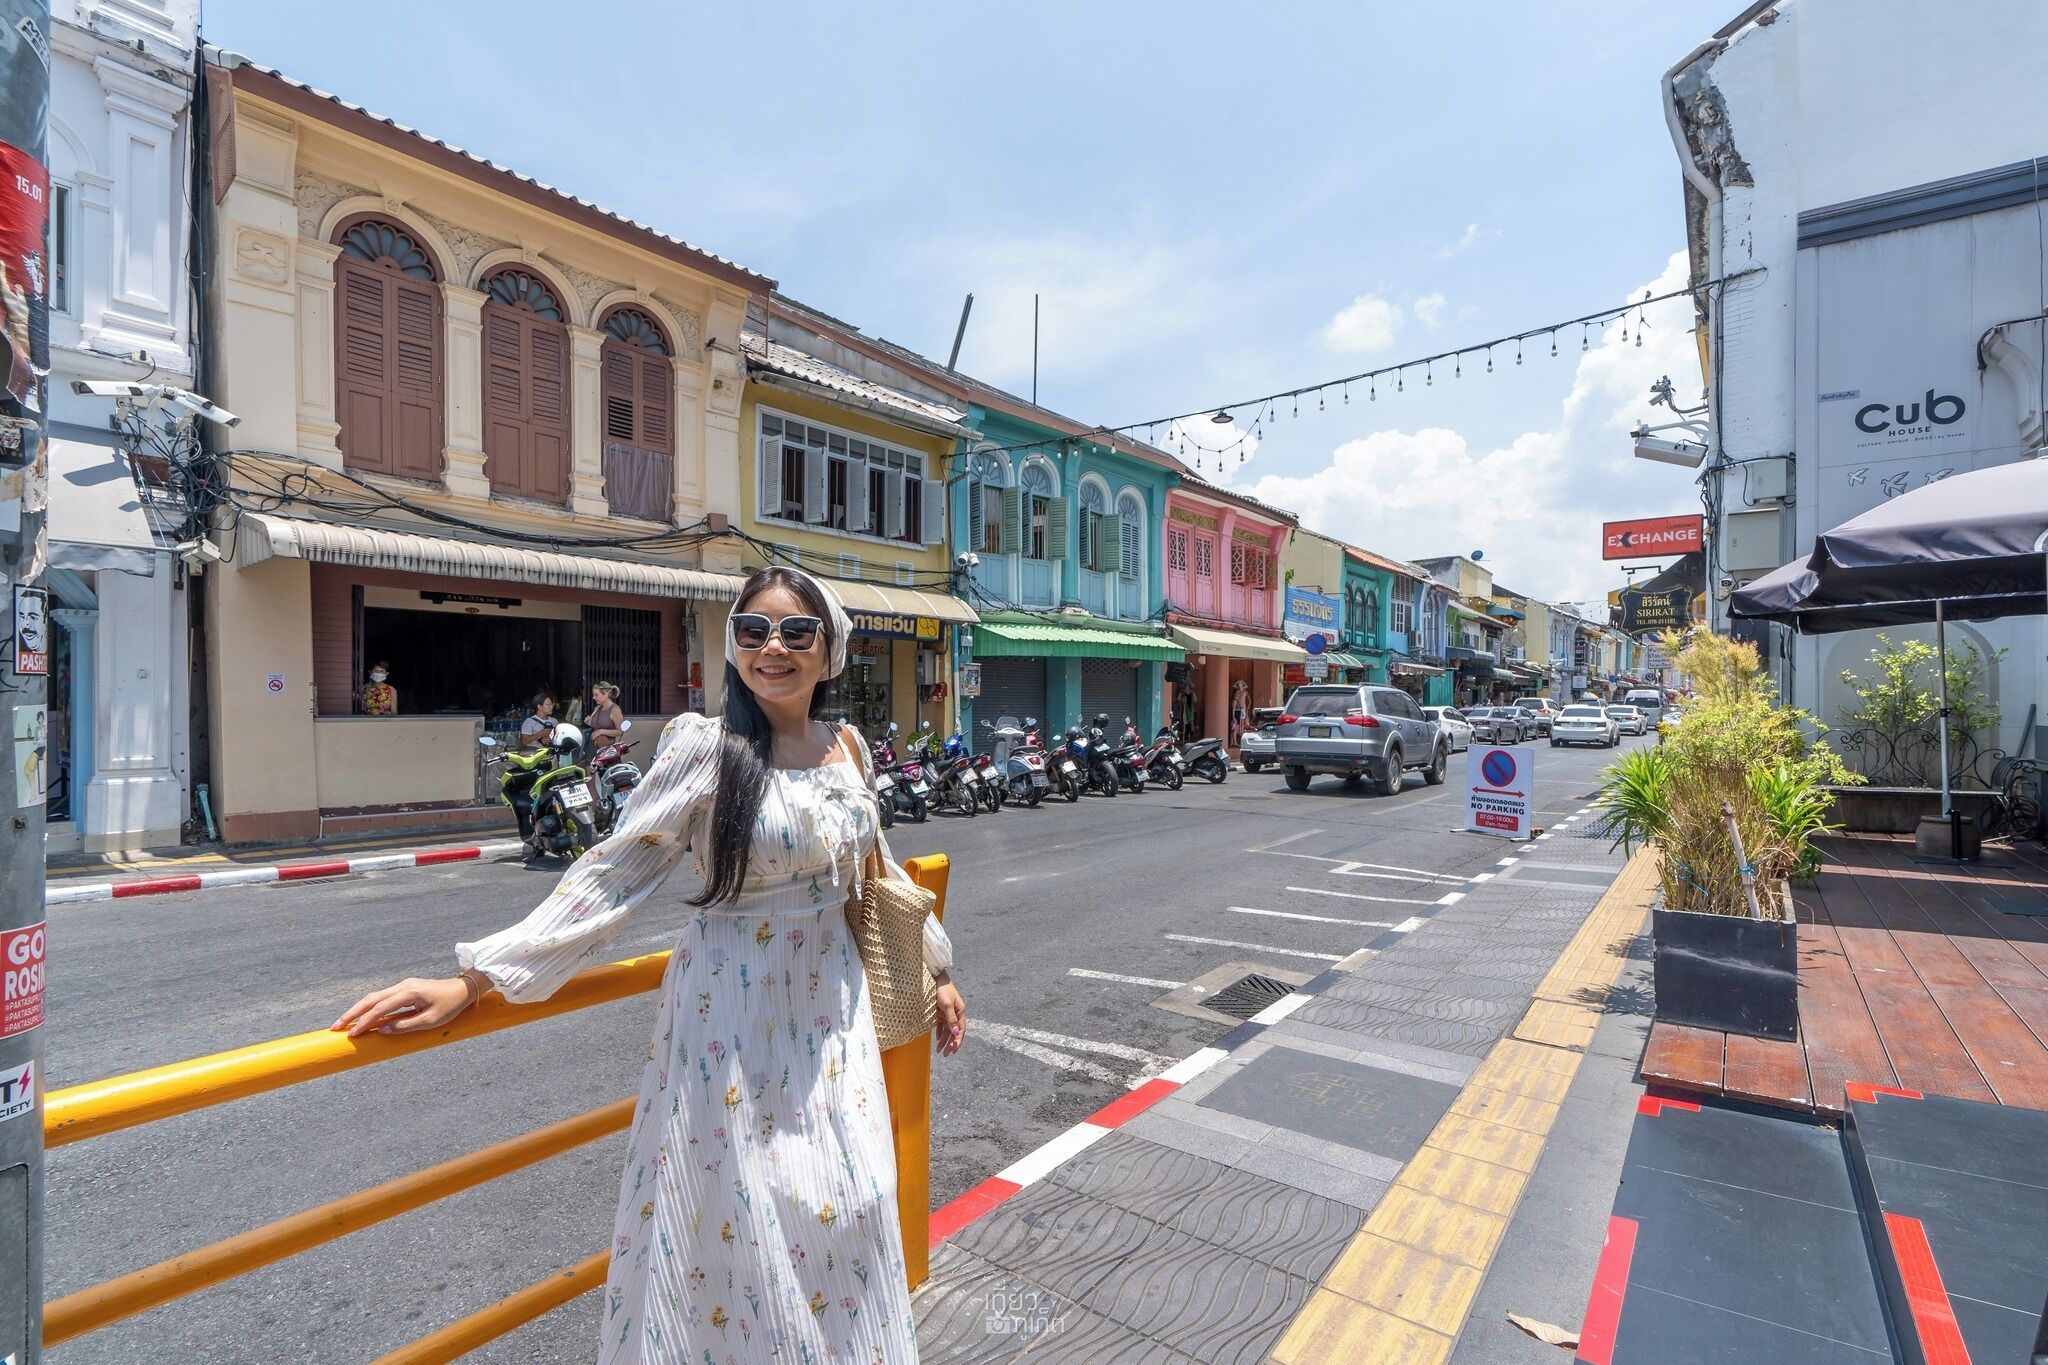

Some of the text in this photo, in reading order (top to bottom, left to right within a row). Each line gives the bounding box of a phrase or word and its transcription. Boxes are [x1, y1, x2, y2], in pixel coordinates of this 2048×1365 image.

[1888, 426, 1931, 437] HOUSE
[1607, 529, 1698, 548] EXCHANGE
[1637, 608, 1675, 617] SIRIRAT
[1471, 802, 1525, 815] NO PARKING
[8, 927, 46, 965] GO
